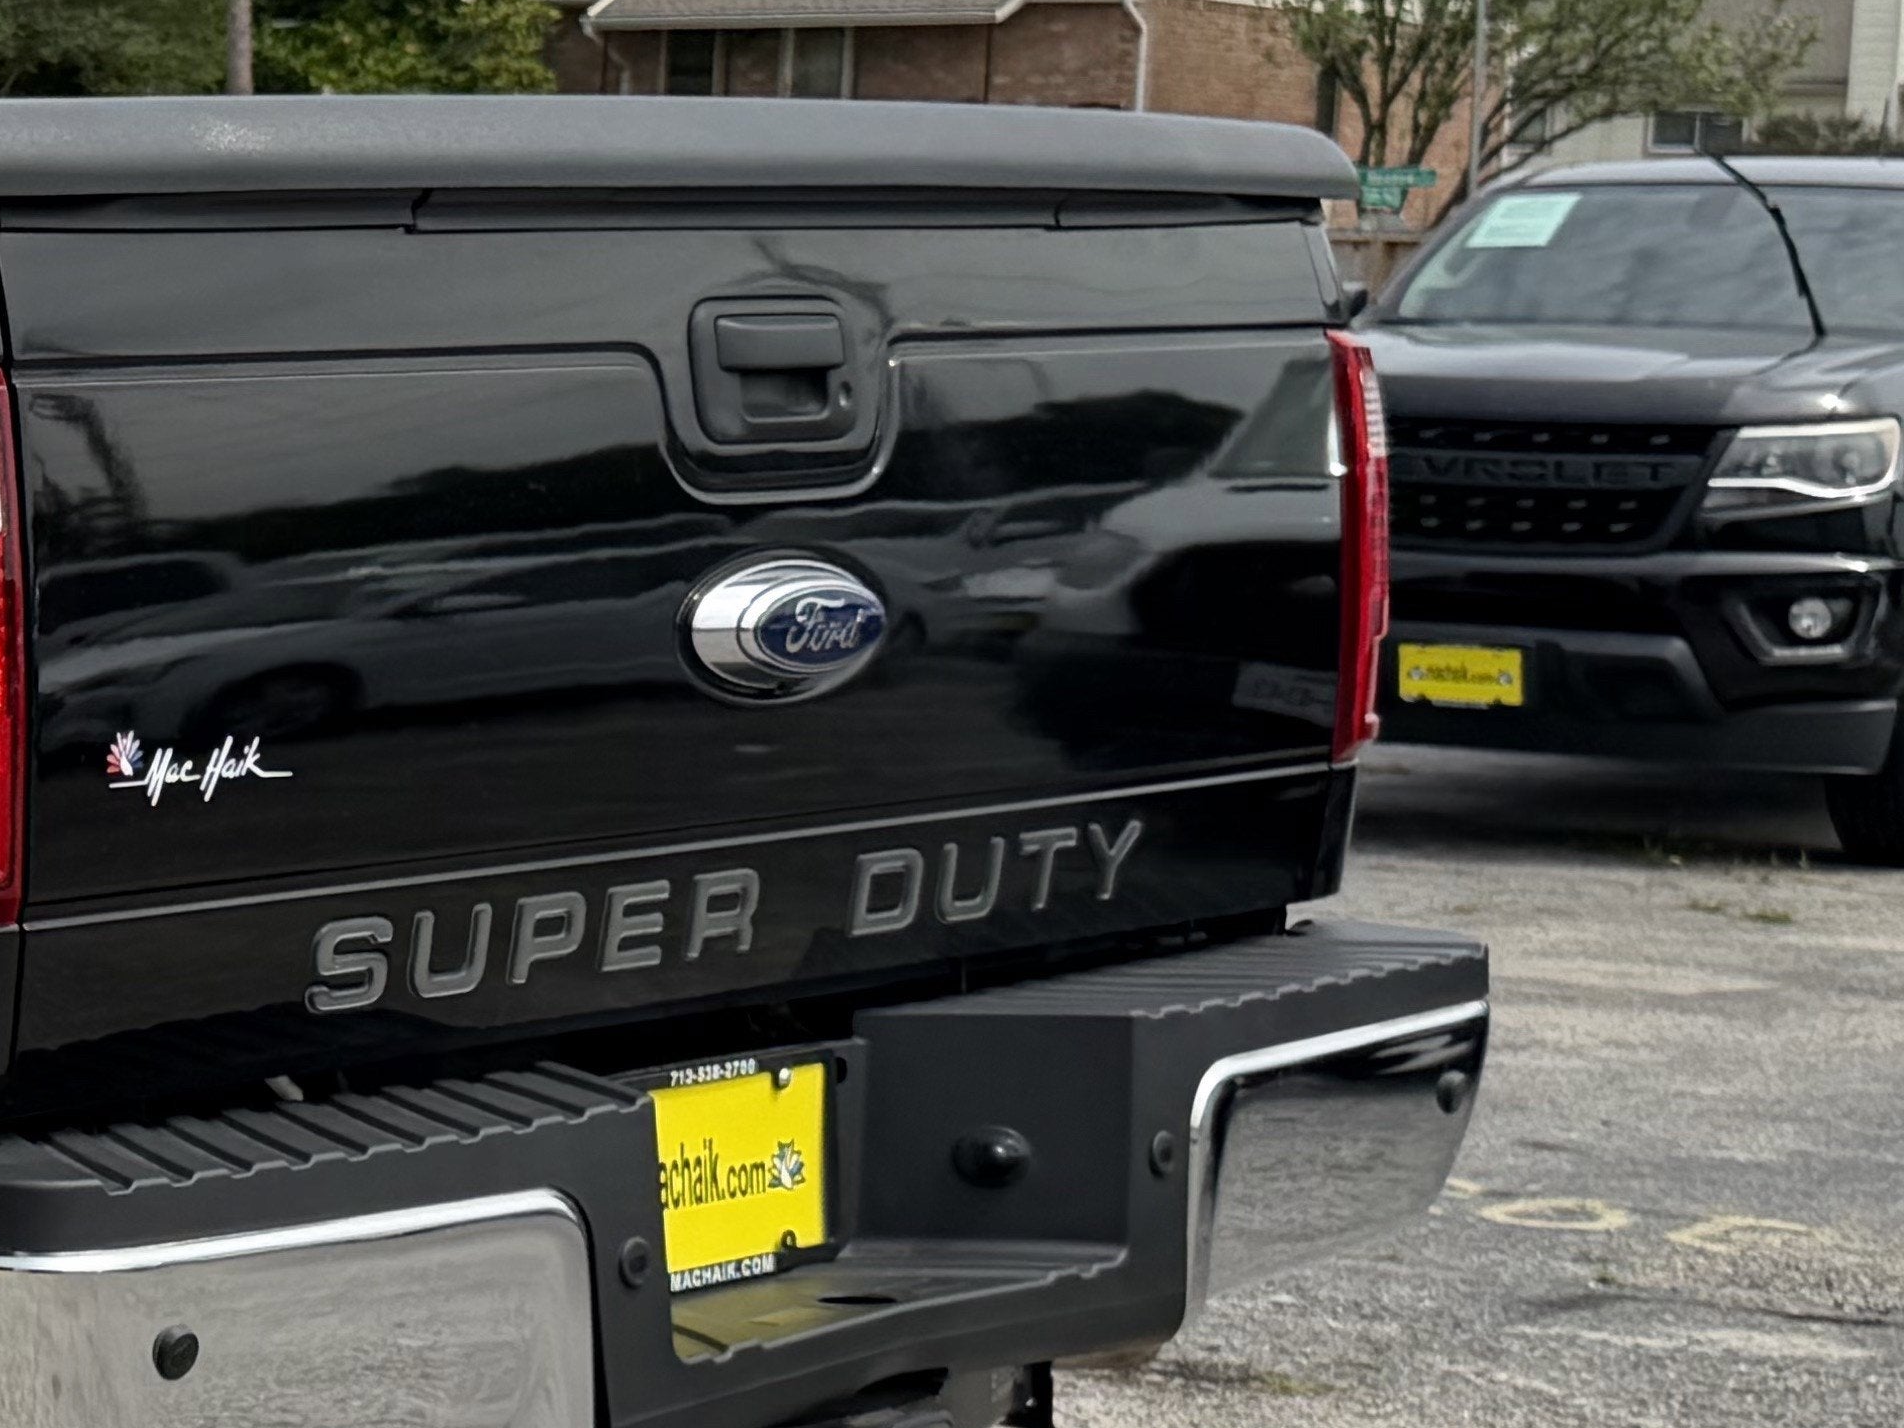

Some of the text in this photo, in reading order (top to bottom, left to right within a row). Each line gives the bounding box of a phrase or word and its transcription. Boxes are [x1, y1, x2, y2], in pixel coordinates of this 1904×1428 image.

[784, 596, 866, 654] Ford
[109, 734, 293, 807] Mac Haik
[303, 817, 1145, 1014] SUPER DUTY
[657, 1136, 767, 1210] achaik.com
[670, 1253, 776, 1292] MACHAIK.COM
